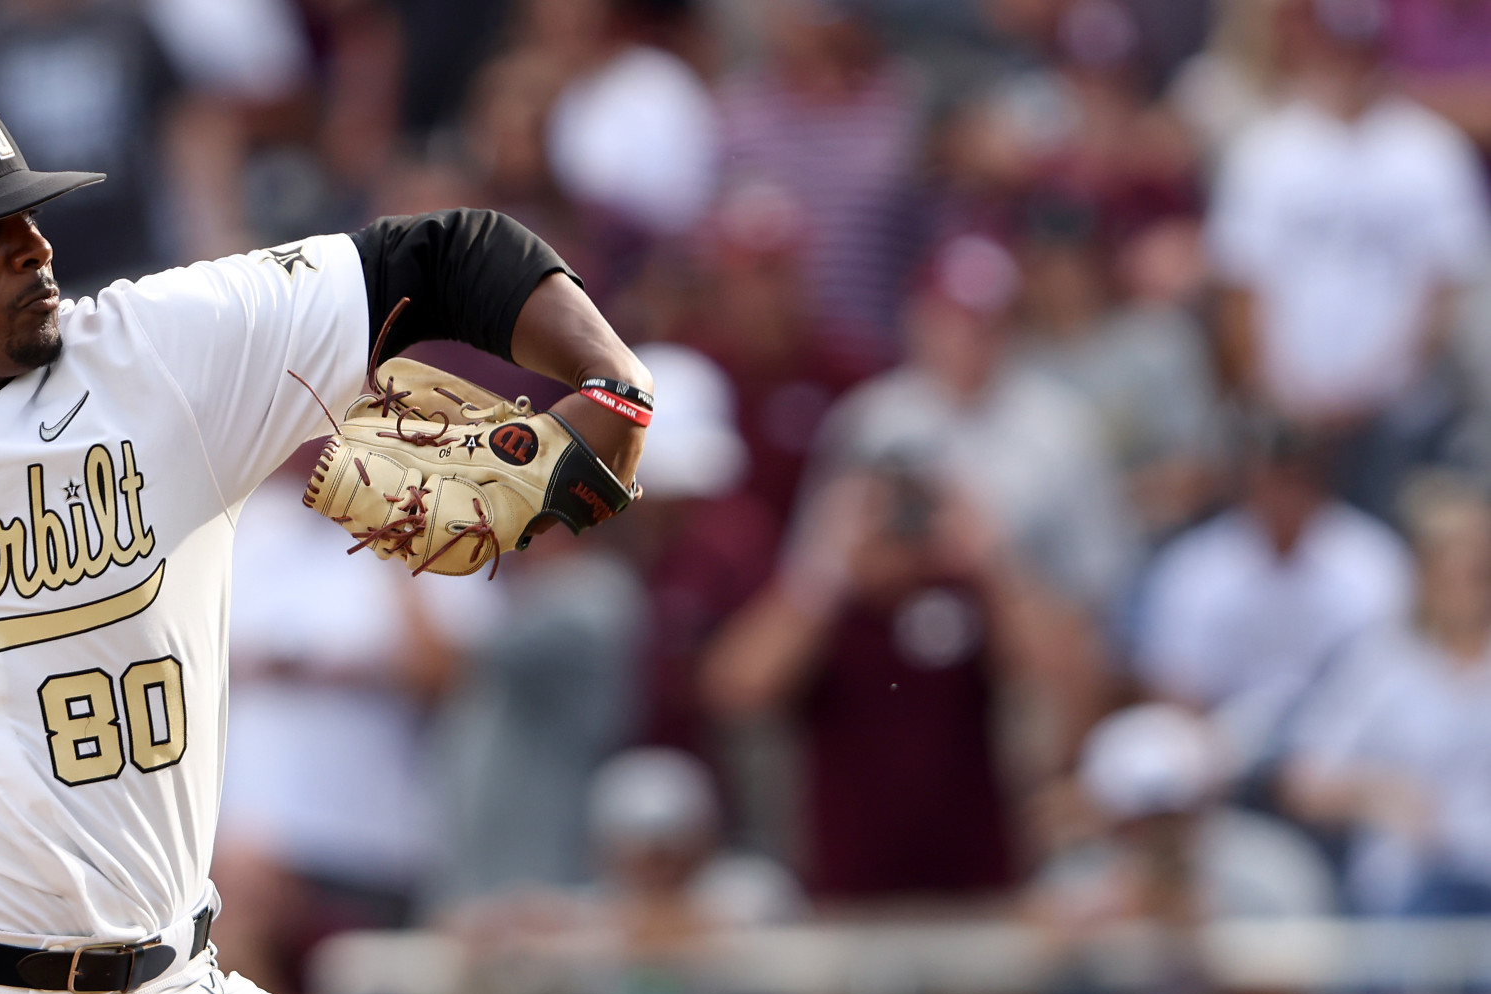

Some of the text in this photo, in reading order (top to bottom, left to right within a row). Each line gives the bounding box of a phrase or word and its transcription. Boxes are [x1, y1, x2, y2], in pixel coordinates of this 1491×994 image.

[592, 389, 637, 419] TEAM JACK
[37, 654, 187, 787] 80
